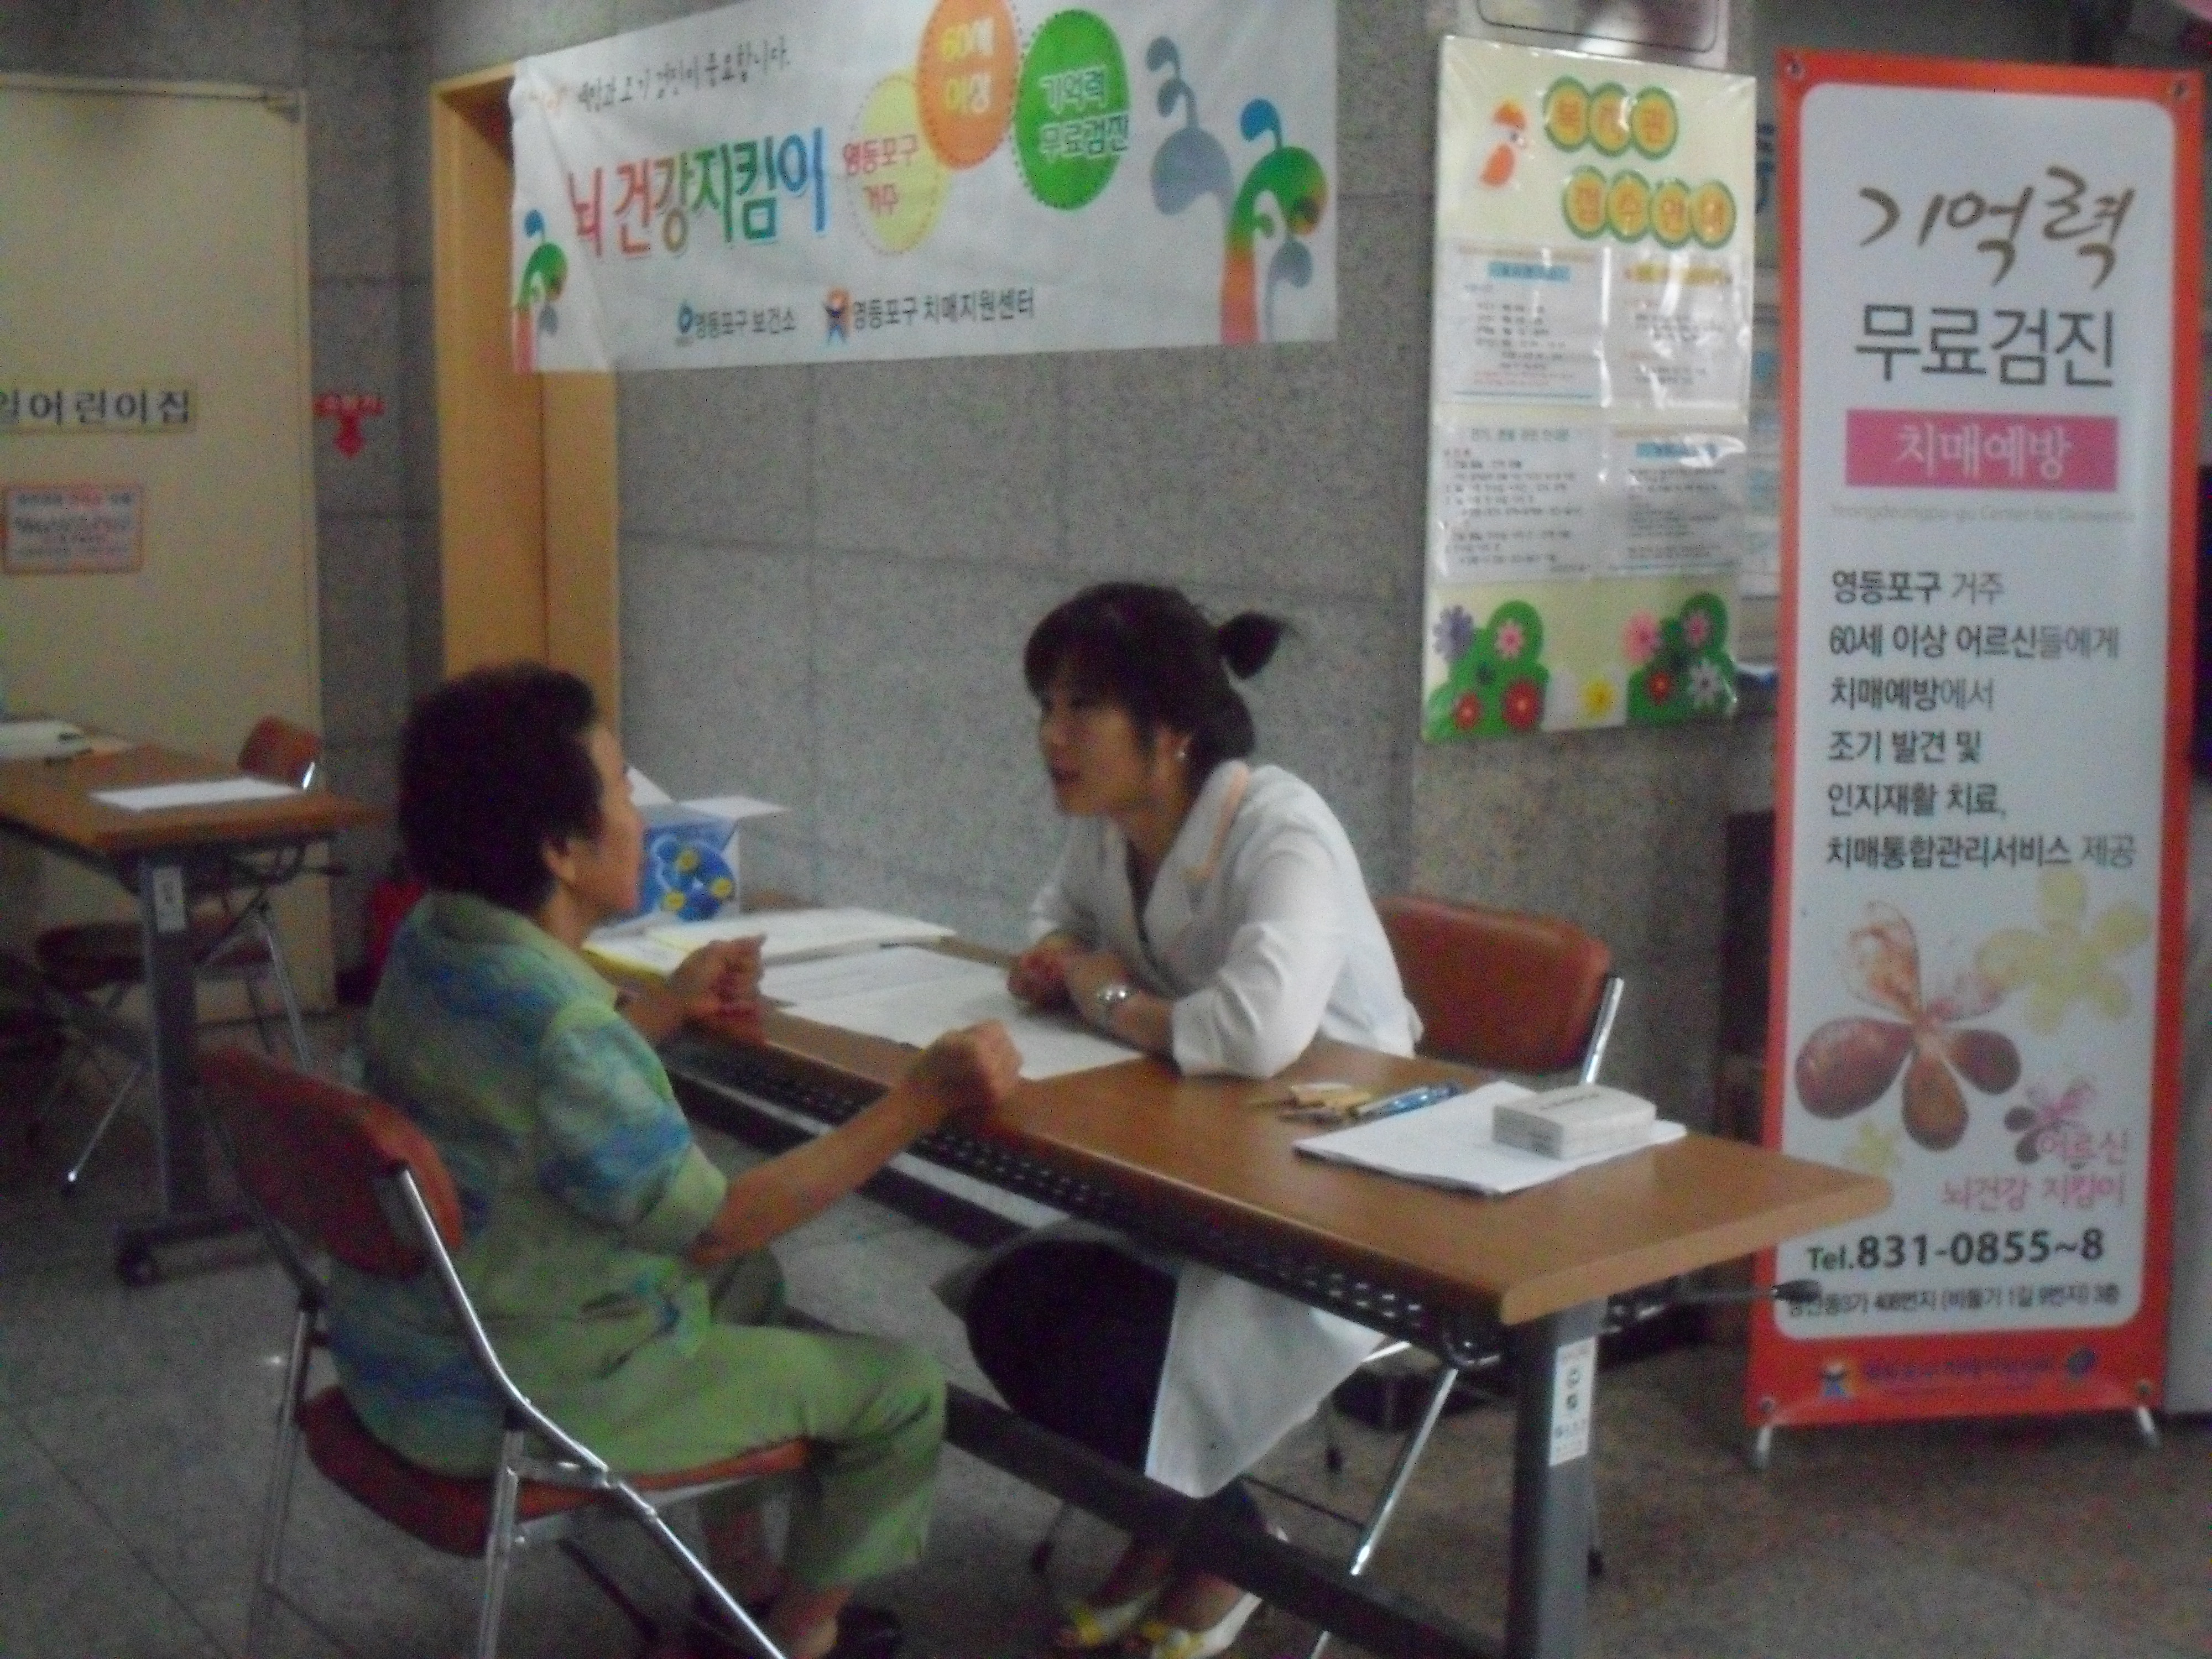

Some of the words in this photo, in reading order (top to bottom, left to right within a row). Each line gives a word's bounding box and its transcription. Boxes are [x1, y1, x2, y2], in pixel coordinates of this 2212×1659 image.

[1038, 63, 1108, 114] 기억력
[843, 133, 920, 175] 영등포구
[613, 126, 827, 259] 건강지킴이
[1858, 165, 2135, 290] 기억력
[695, 309, 749, 340] 영등포구
[752, 305, 797, 336] 보건소
[853, 294, 919, 331] 영등포구
[922, 286, 1036, 324] 치매지원센터
[1855, 303, 2114, 388] 무료검진
[1895, 422, 2073, 481] 치매예방
[1832, 569, 1943, 605] 영등포구
[1950, 570, 2005, 605] 거주
[1829, 623, 1884, 657] 60세
[1892, 624, 1947, 658] 이상
[1955, 624, 2121, 659] 어르신들에게
[1829, 676, 1995, 711] 치매예방에서
[1827, 730, 1882, 763] 조기
[1891, 730, 1946, 764] 발견
[1955, 730, 1983, 764] 및
[1827, 782, 1937, 817] 인지재활
[1945, 782, 2007, 818] 치료,
[1826, 835, 2073, 869] 치매통합관리서비스
[2080, 835, 2135, 869] 제공
[1807, 1228, 2105, 1273] Tel.831-0855~8
